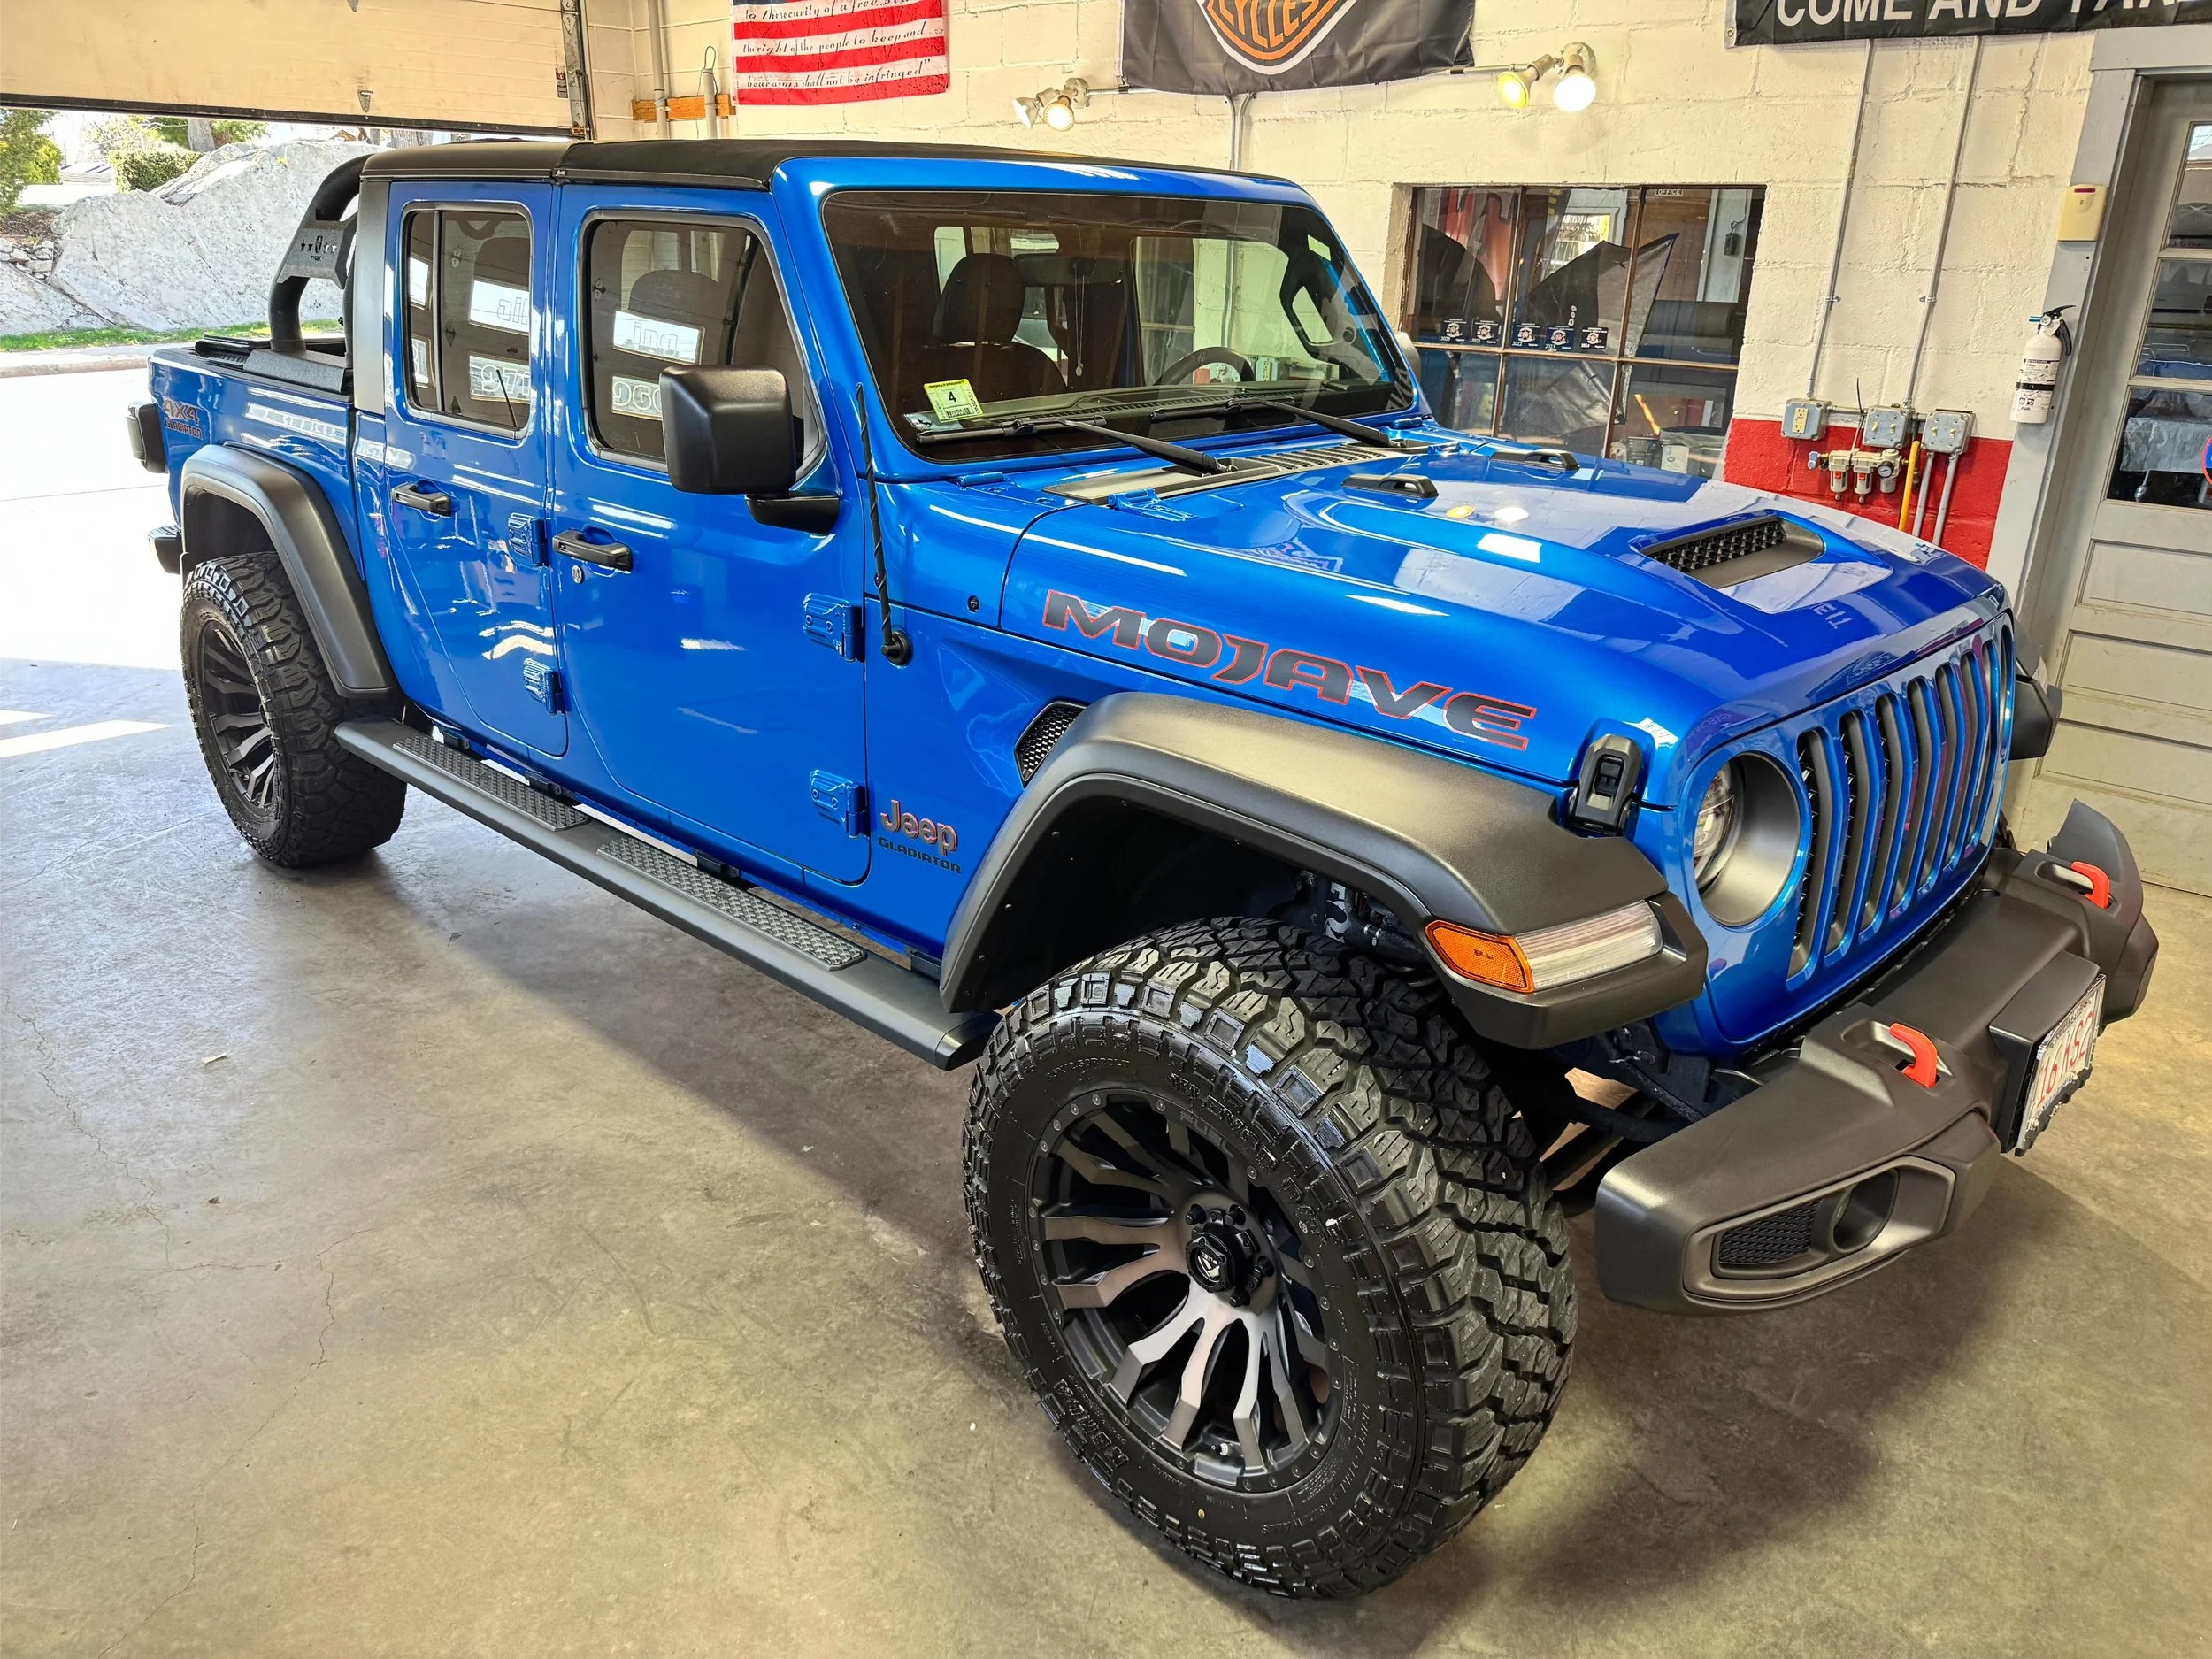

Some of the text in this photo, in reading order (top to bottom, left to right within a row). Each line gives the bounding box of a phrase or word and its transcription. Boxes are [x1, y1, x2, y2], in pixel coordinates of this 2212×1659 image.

[1777, 0, 1913, 27] COME
[757, 40, 787, 56] right
[800, 39, 814, 52] the
[819, 32, 850, 54] people
[854, 35, 865, 45] to
[872, 29, 902, 46] keep
[903, 21, 927, 39] and
[826, 75, 842, 86] not
[847, 70, 860, 84] be
[949, 391, 956, 403] 4
[1042, 588, 1538, 752] MOJAVE
[879, 799, 959, 856] Jeep
[877, 836, 962, 875] GLADIATOR
[1179, 1110, 1235, 1158] FUEL
